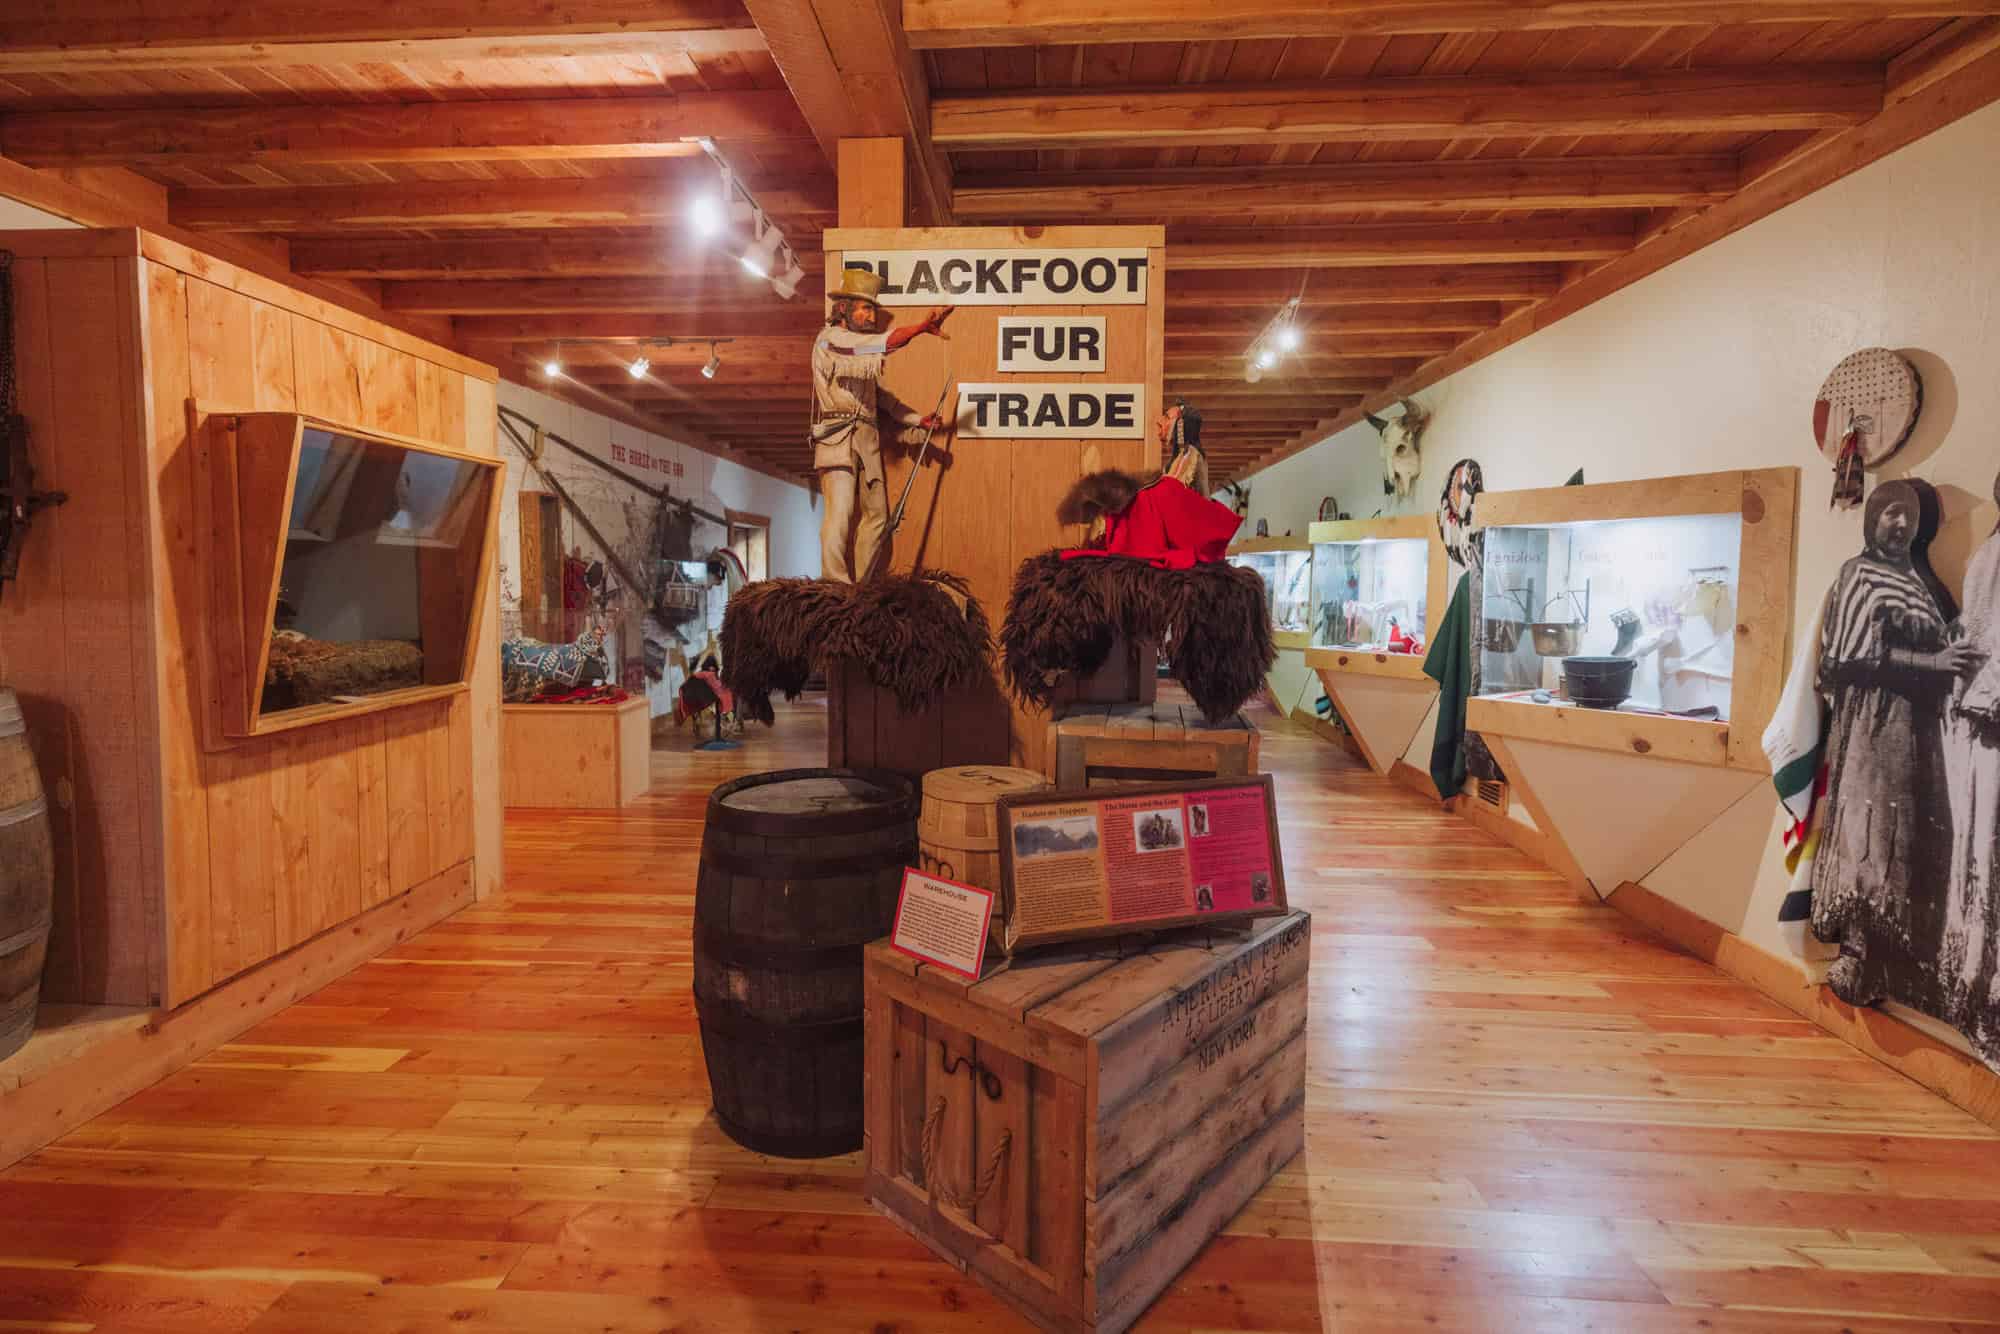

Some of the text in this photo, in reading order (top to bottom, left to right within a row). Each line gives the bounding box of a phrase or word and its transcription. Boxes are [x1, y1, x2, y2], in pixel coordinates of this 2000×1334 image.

[1001, 326, 1100, 361] FUR
[968, 393, 1134, 428] TRADE
[923, 883, 968, 902] WAREHOUSE
[1162, 950, 1252, 1032] AMERICAN
[1208, 976, 1258, 1024] LIBERTY
[1198, 1014, 1257, 1072] NEW YORK
